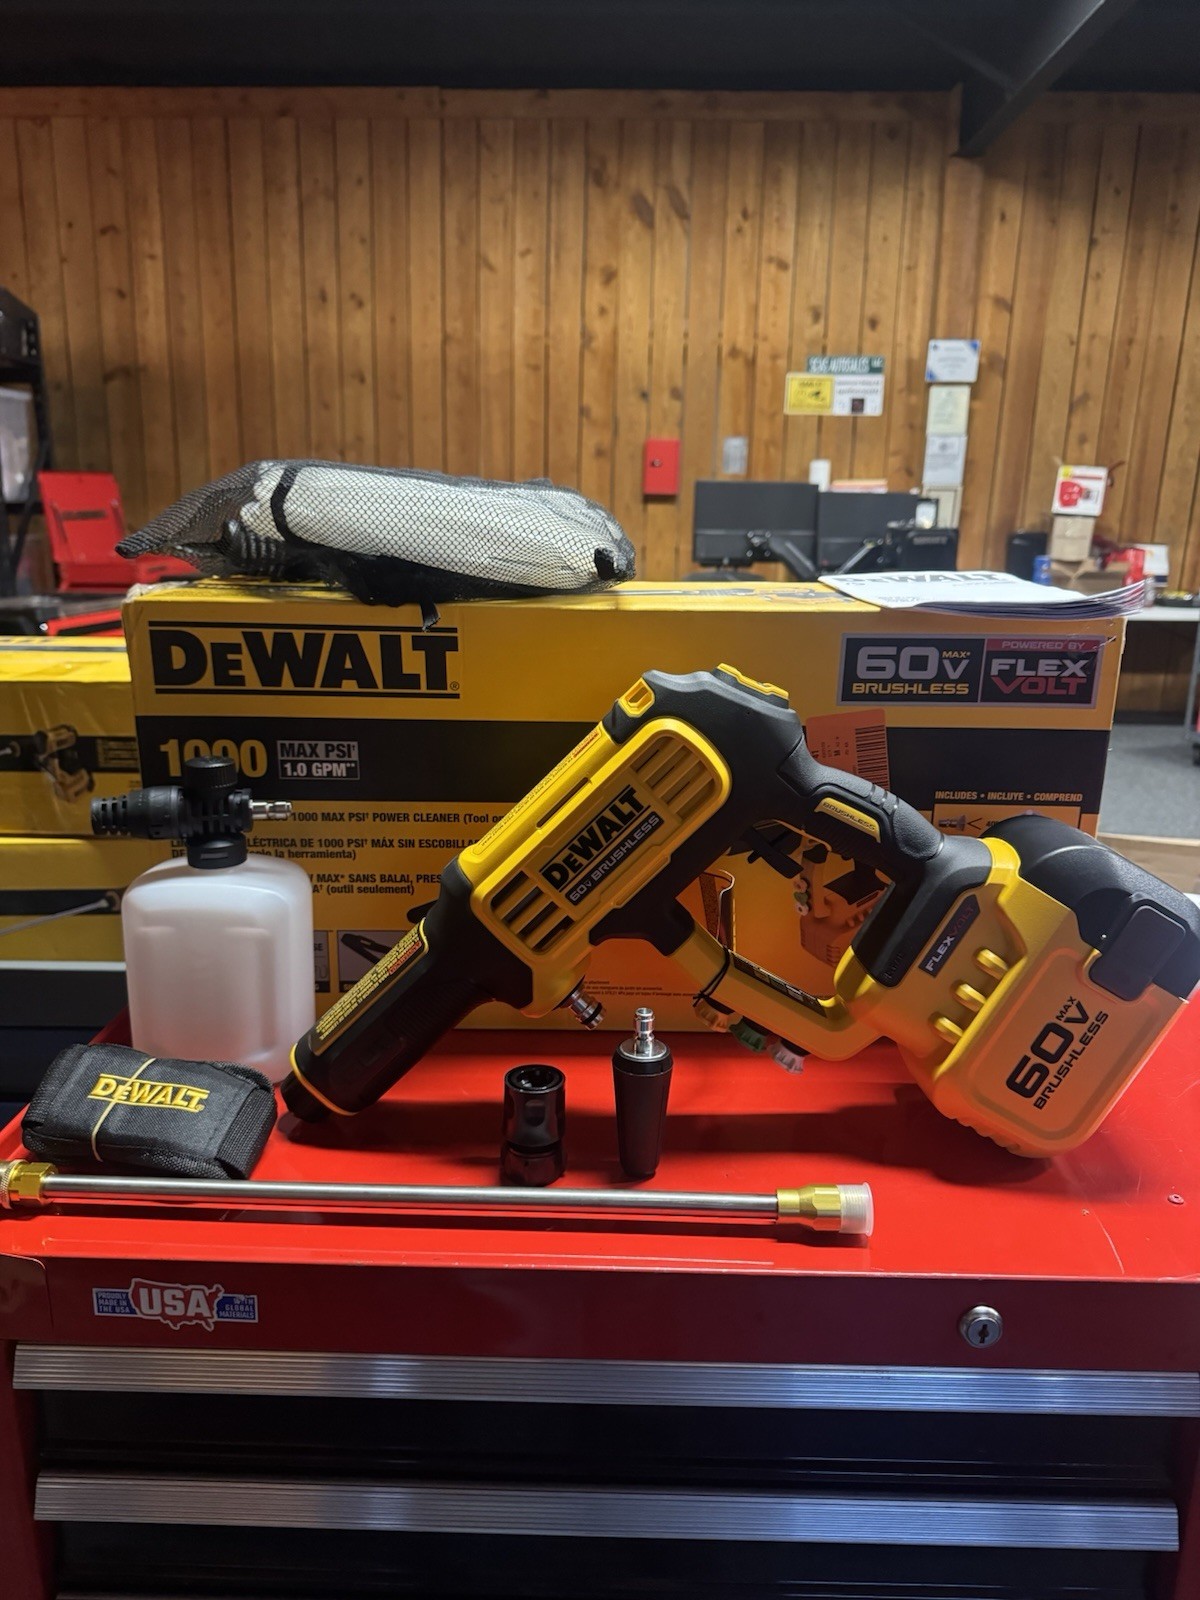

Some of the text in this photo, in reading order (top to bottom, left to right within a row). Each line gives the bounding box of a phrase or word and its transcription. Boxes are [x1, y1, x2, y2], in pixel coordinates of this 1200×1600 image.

[1002, 641, 1085, 650] POWERED BY
[149, 629, 458, 690] DEWALT
[990, 659, 1090, 677] FLEX
[852, 682, 970, 695] BRUSHLESS
[991, 677, 1087, 695] VOLT
[280, 743, 320, 758] MAX
[284, 762, 307, 777] 1.0
[935, 791, 1083, 802] INCLUDES INCLUYE COMPREND
[291, 812, 318, 822] 1000
[321, 812, 345, 822] MAX
[373, 812, 410, 823] POWER
[414, 813, 460, 823] CLEANER
[463, 813, 489, 825] (Tool
[822, 802, 876, 831] BRUSHLESS
[247, 836, 298, 848] LÉCTRICA
[301, 838, 314, 848] DE
[318, 838, 344, 848] 1000
[371, 836, 395, 848] MÁX
[398, 839, 416, 848] SIN
[542, 787, 644, 890] DEWALT
[288, 849, 356, 860] herramienta)
[591, 815, 660, 881] BRUSHLESS
[348, 874, 376, 883] SANS
[380, 874, 413, 885] BALAI,
[327, 885, 354, 895] (outil
[357, 885, 415, 895] seulement)
[1056, 995, 1077, 1021] MAX
[1033, 1010, 1109, 1110] BRUSHLESS
[90, 1077, 209, 1109] DEWALT
[139, 1287, 212, 1317] USA
[224, 1303, 254, 1312] GLOBAL
[218, 1310, 254, 1319] MATERIALS
